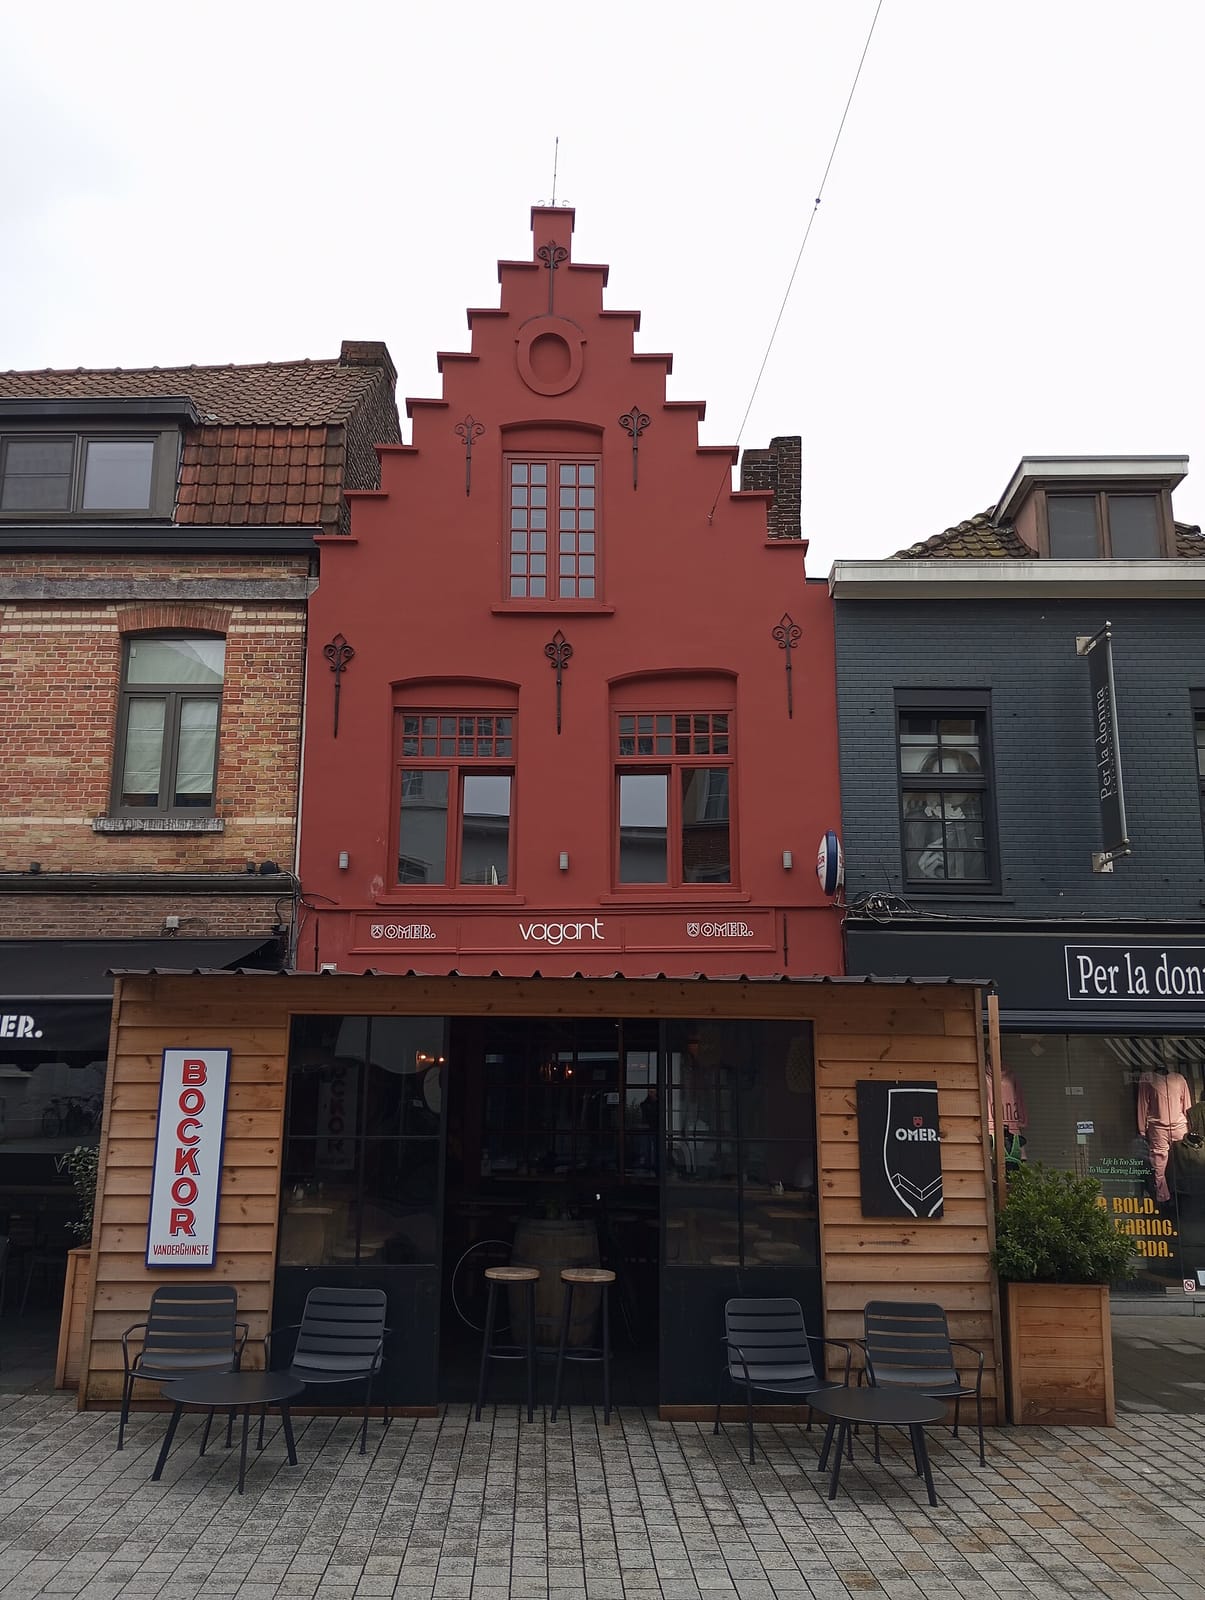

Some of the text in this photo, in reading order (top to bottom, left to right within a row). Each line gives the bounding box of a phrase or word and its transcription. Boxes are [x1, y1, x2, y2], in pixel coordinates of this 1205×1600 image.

[1096, 687, 1107, 744] donna
[1097, 747, 1109, 767] la
[1100, 768, 1112, 800] Per
[384, 924, 437, 939] OMER.
[519, 917, 605, 945] vagant
[700, 922, 754, 937] OMER.
[1076, 952, 1205, 995] Per la don
[0, 1015, 43, 1038] ER.
[895, 1128, 942, 1142] OMER.
[169, 1059, 208, 1237] BOCKOR
[1112, 1197, 1160, 1214] BOLD.
[153, 1243, 209, 1256] VANDERGHINSTE
